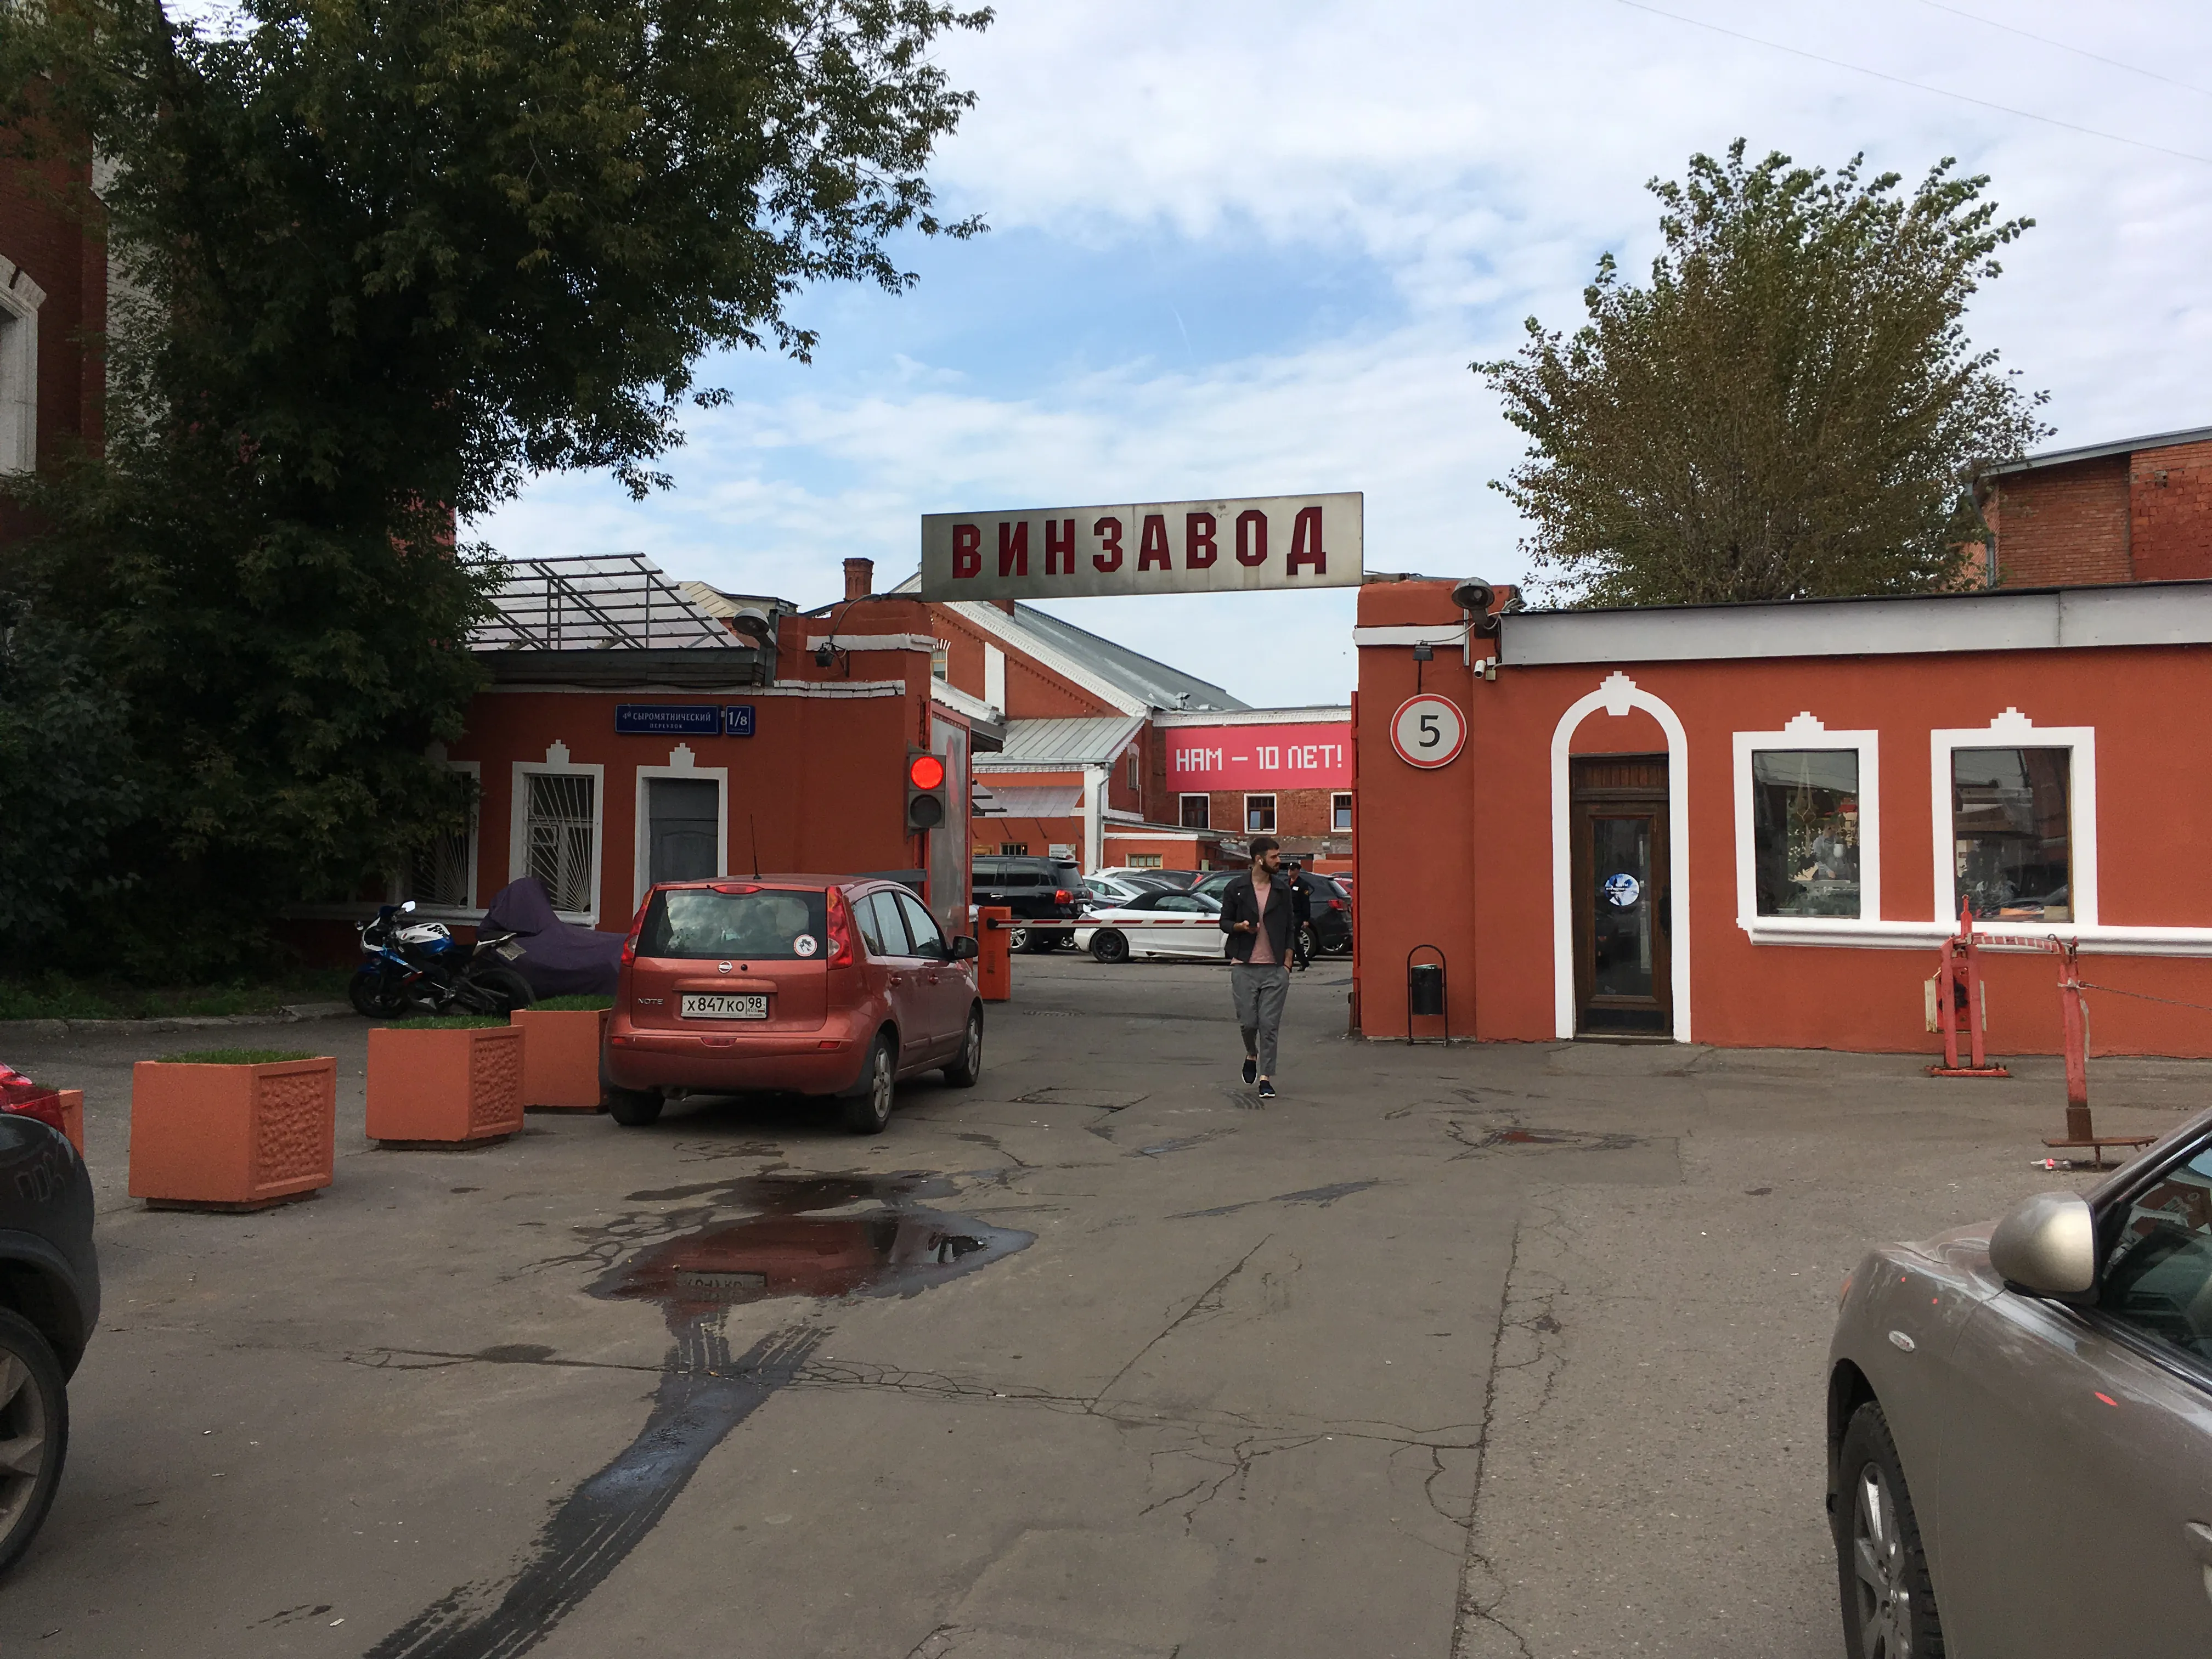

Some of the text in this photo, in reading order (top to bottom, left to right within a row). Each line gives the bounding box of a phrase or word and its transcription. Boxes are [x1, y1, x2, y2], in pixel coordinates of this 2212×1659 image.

[952, 506, 1327, 579] ВИНЗАВОД
[633, 712, 710, 721] СЫРОМЯТНИЧЕСКИЙ
[729, 711, 747, 727] 1/8
[1419, 715, 1440, 748] 5
[1176, 748, 1222, 771] НАМ
[1256, 746, 1279, 769] 10
[1288, 744, 1342, 769] ЛЕТ!
